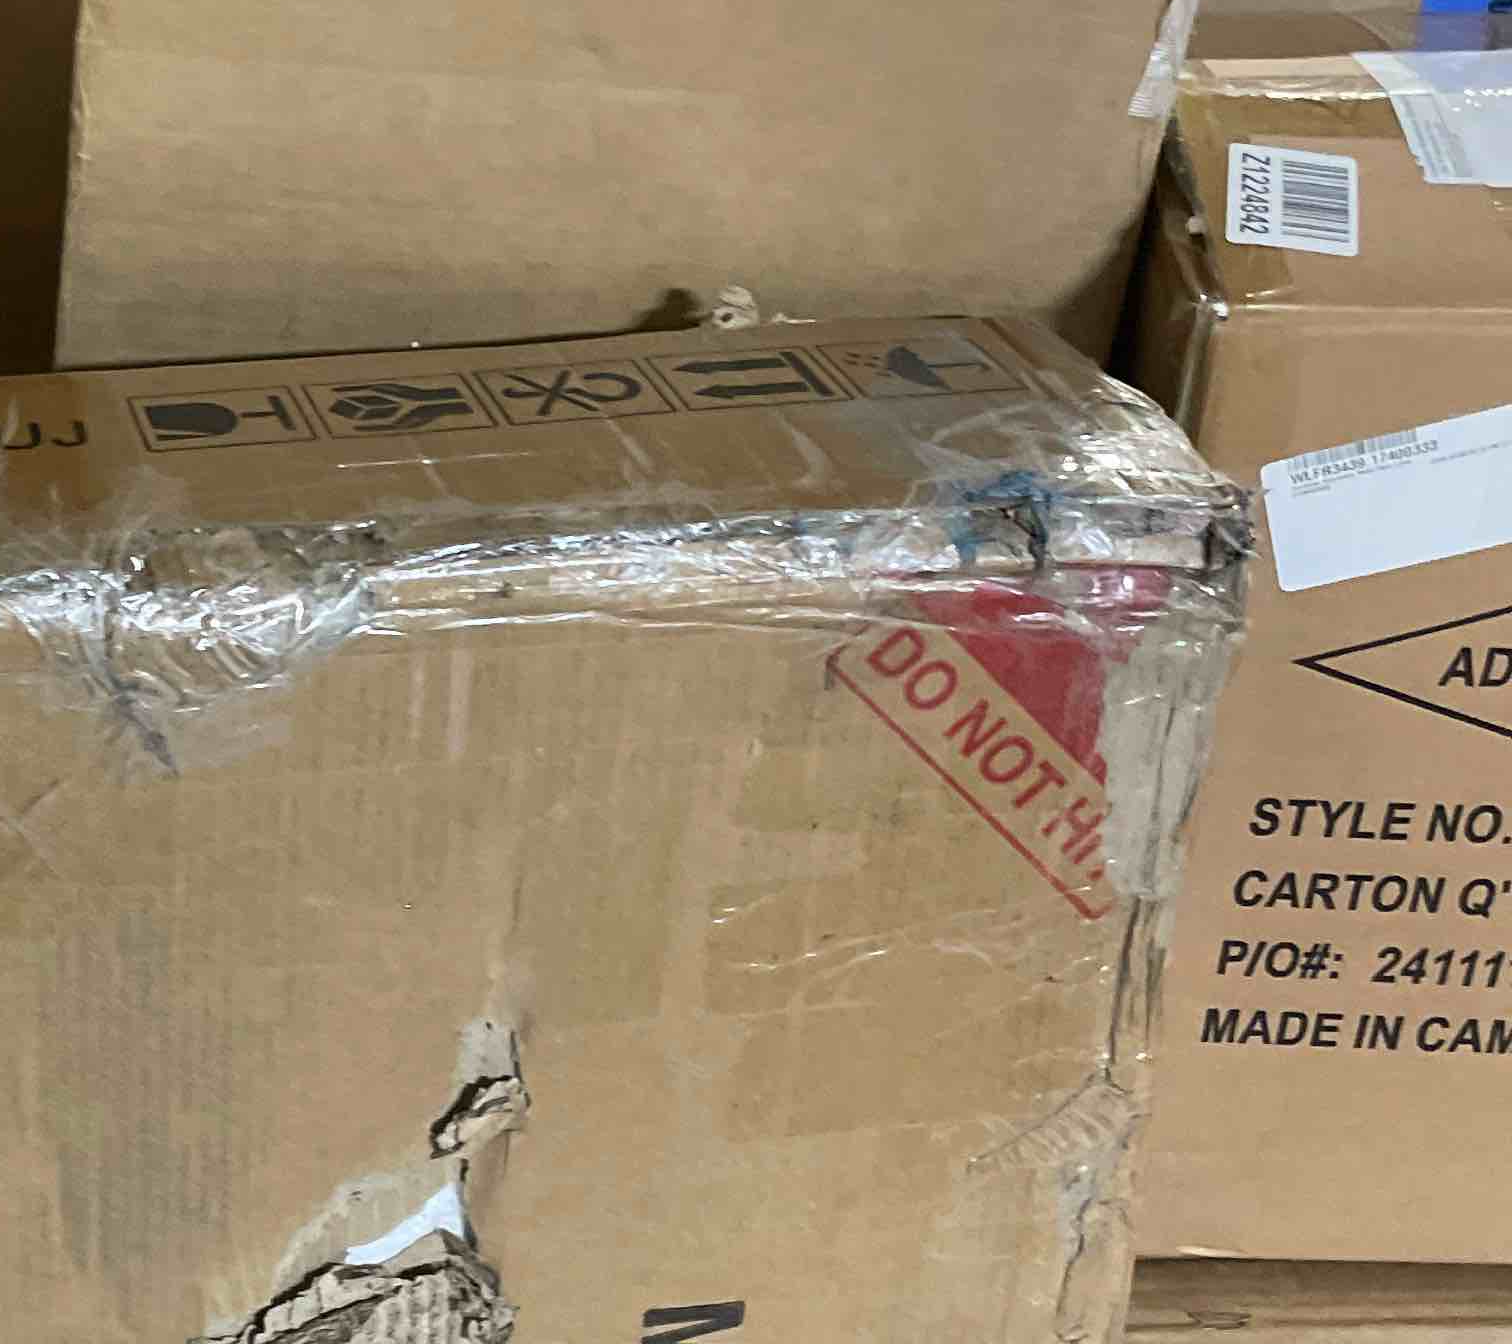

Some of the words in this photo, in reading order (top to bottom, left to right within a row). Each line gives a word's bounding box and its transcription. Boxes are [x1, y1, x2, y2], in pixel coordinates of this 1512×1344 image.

[1437, 645, 1512, 688] AD
[866, 627, 959, 711] DO
[944, 698, 1067, 810] NOT
[1041, 795, 1106, 882] HI
[1249, 798, 1417, 841] STYLE
[1426, 803, 1512, 845] NO.
[1233, 869, 1446, 914] CARTON
[1216, 939, 1343, 980] P/O#:
[1371, 946, 1512, 988] 24111
[1200, 1007, 1344, 1048] MADE
[1352, 1014, 1405, 1051] IN
[1415, 1016, 1512, 1055] CAM
